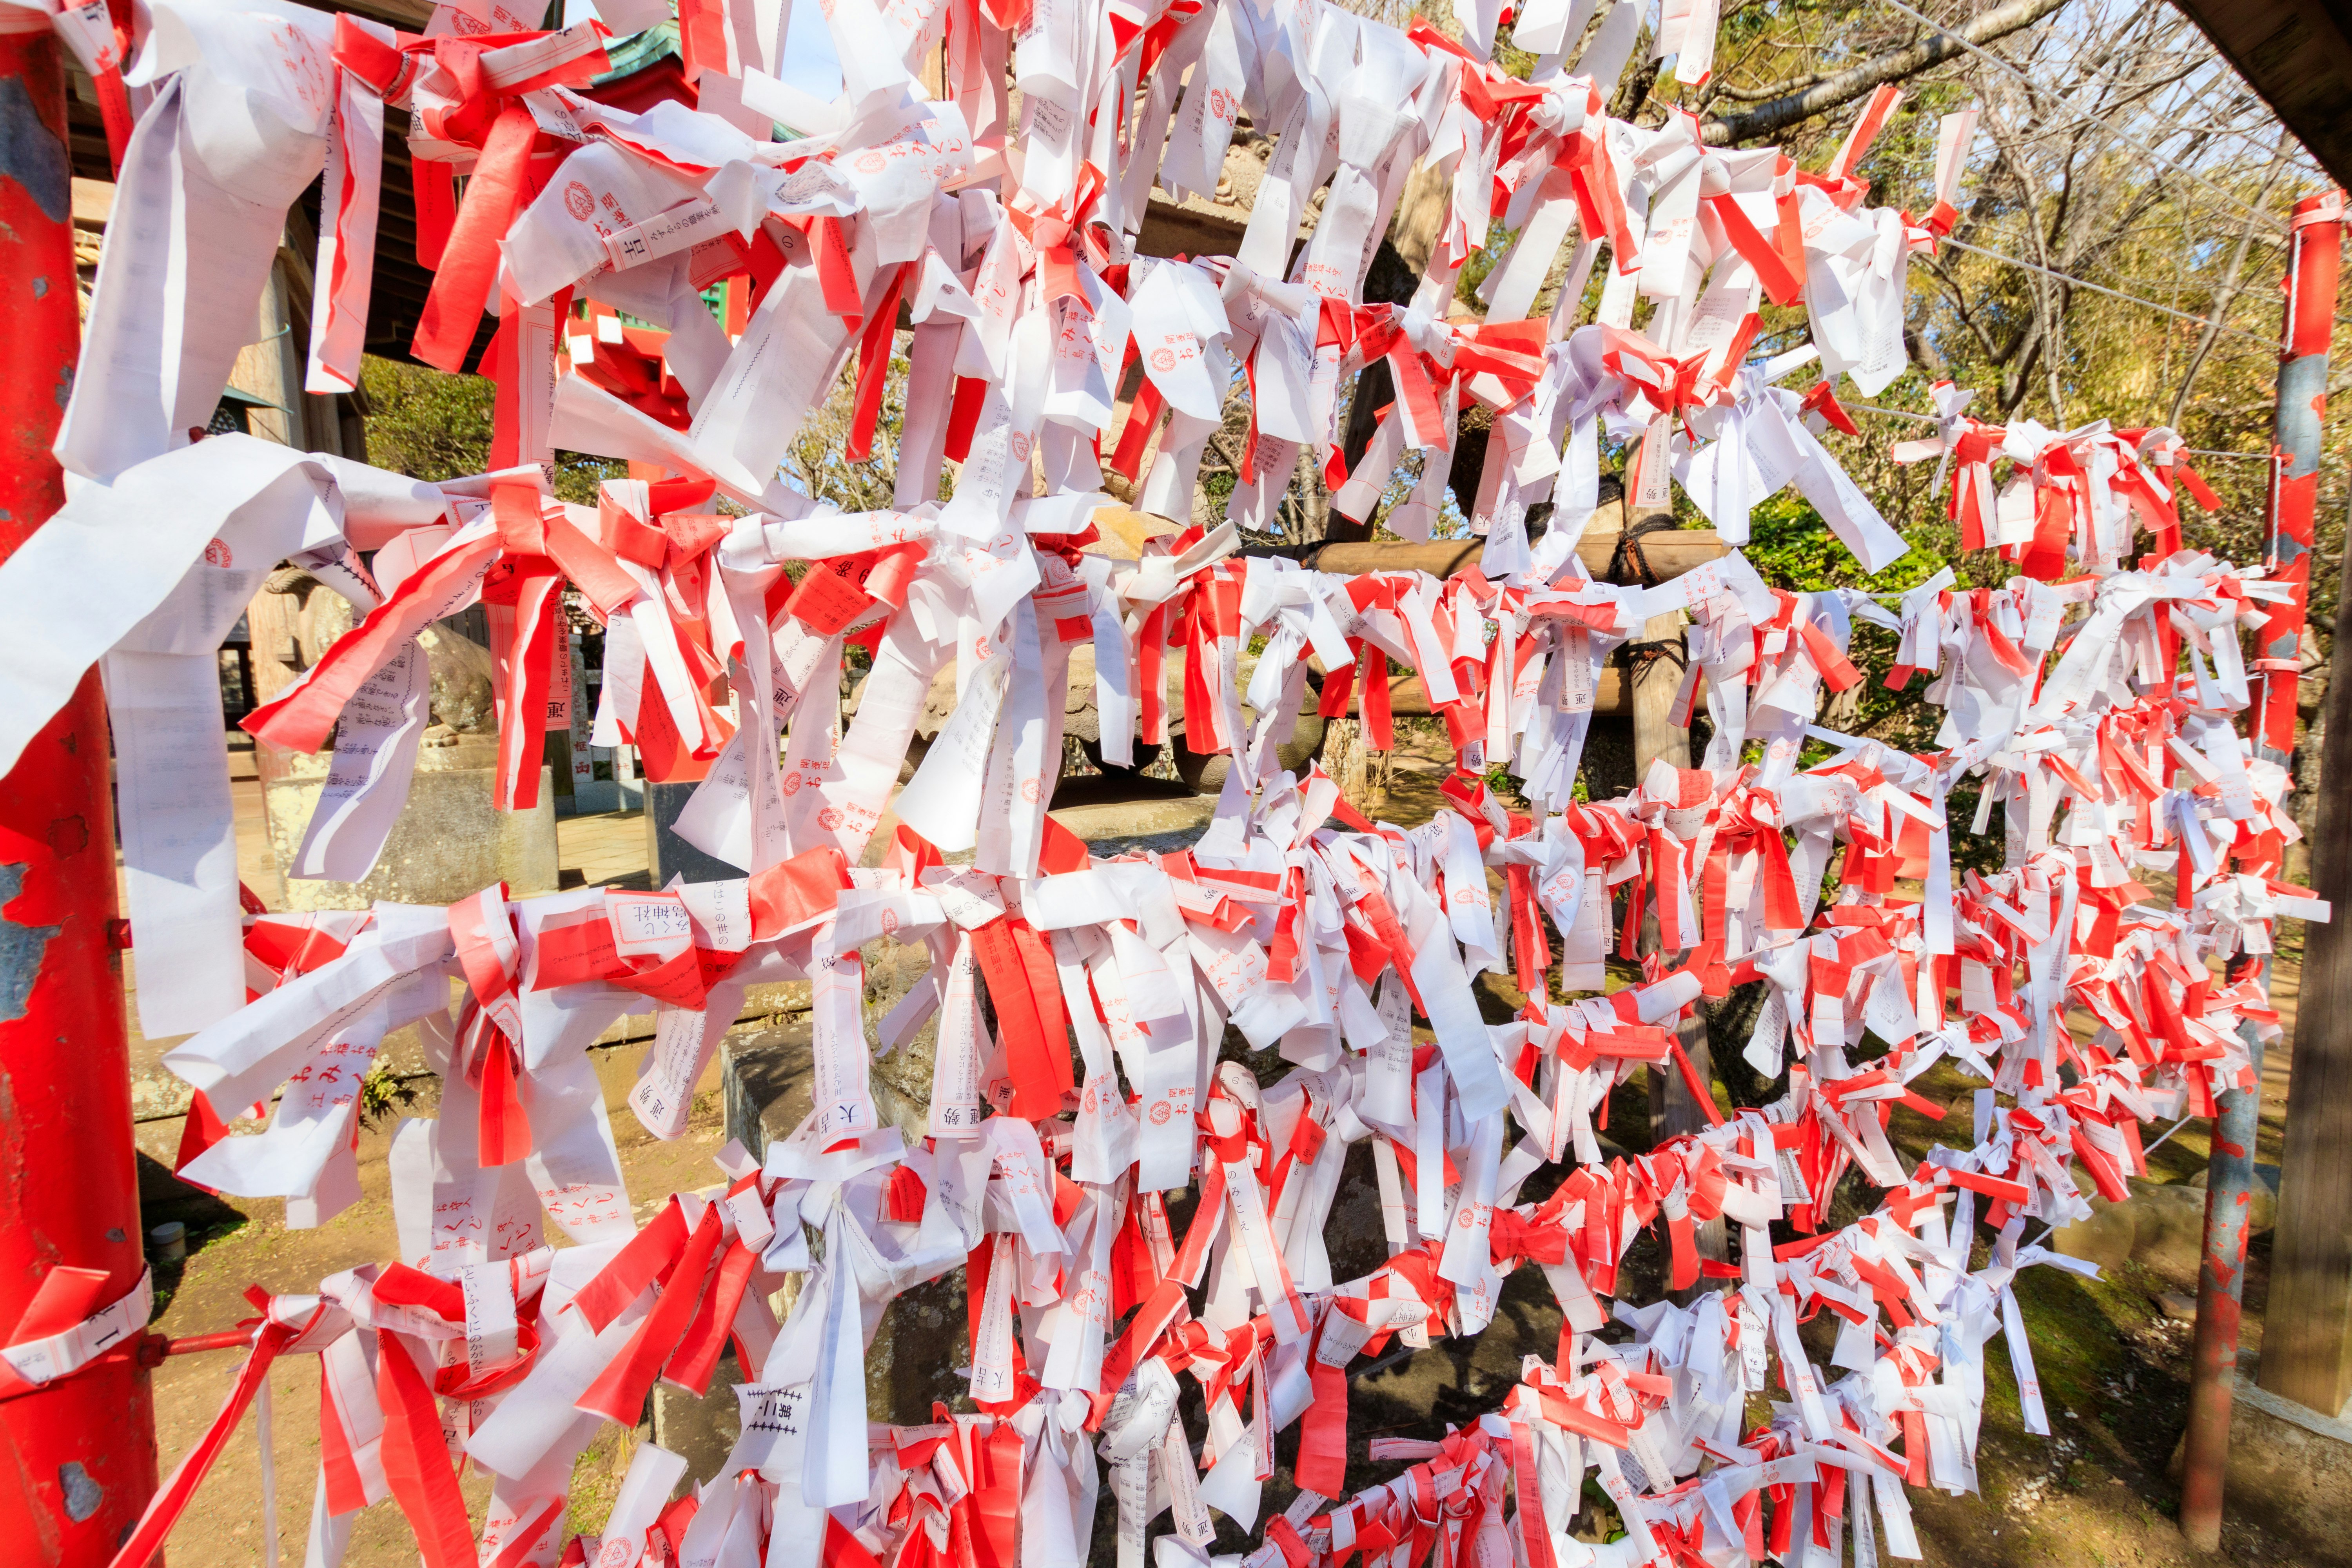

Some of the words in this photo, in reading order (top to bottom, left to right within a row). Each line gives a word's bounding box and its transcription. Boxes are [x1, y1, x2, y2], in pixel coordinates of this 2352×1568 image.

[1226, 113, 1236, 127] お
[890, 138, 963, 158] おみくじ
[624, 238, 645, 260] 吉
[1061, 330, 1114, 353] みくじ
[1056, 347, 1110, 373] 江島神社
[1180, 349, 1194, 360] お
[773, 688, 792, 706] 運
[547, 701, 565, 718] 運
[1548, 885, 1559, 895] お
[1478, 897, 1488, 908] お
[633, 905, 687, 922] 島神社
[644, 920, 690, 936] みくじ
[1217, 954, 1255, 991] みくじ
[1227, 967, 1268, 1004] 江島神社
[307, 1092, 352, 1108] 江島
[1175, 1102, 1188, 1116] お
[549, 1192, 614, 1214] みくじ
[1227, 1170, 1250, 1233] のみこえ
[1407, 1216, 1418, 1225] お
[1477, 1219, 1487, 1228] お
[500, 1224, 531, 1251] くじ
[1398, 1302, 1414, 1312] くじ
[976, 1367, 1005, 1389] 大吉
[1181, 1520, 1212, 1537] 運勢
